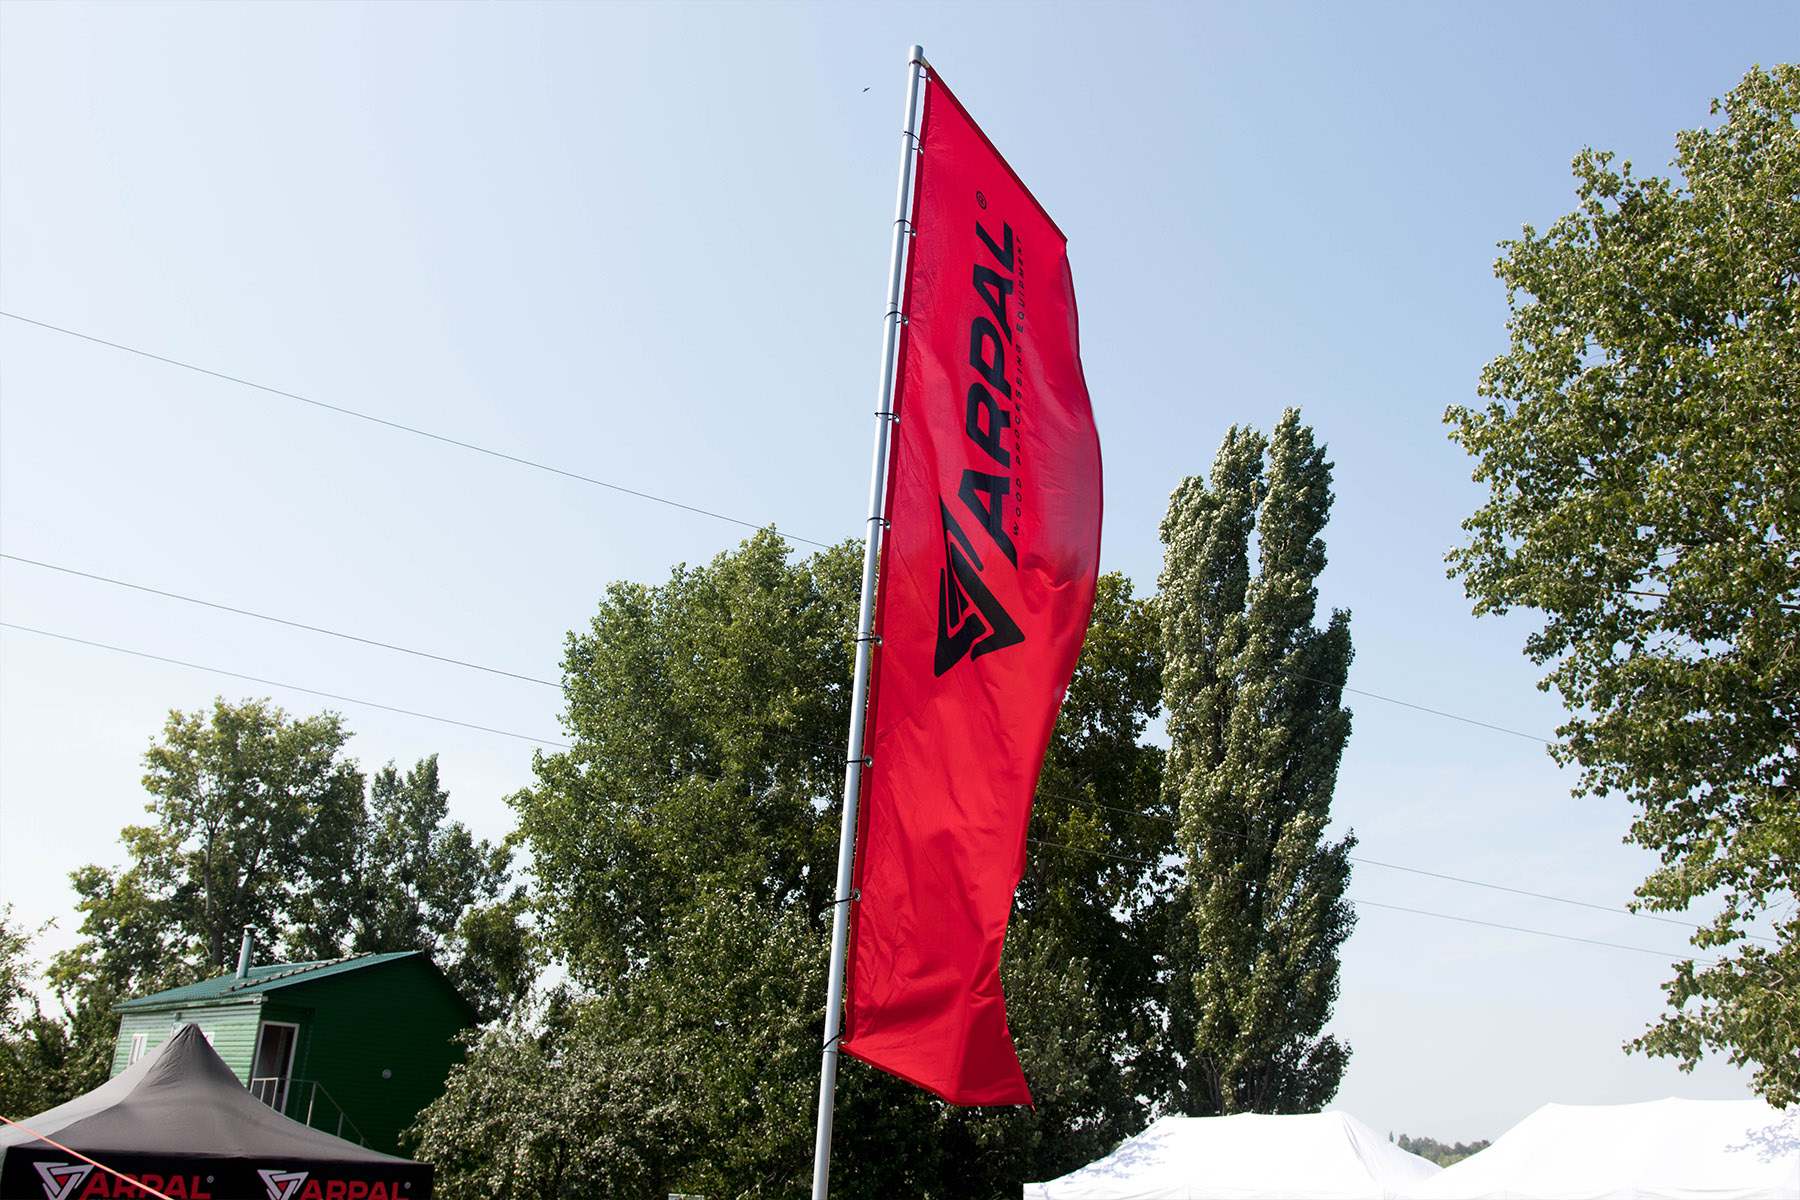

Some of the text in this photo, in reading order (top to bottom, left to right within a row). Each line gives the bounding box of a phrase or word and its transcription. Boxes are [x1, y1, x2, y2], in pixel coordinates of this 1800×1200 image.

[957, 220, 1017, 570] ARPAL
[1013, 235, 1026, 536] WOOD PROCESSING EQUIPMENT
[79, 1172, 212, 1200] ARPAL
[300, 1179, 409, 1200] ARPAL
